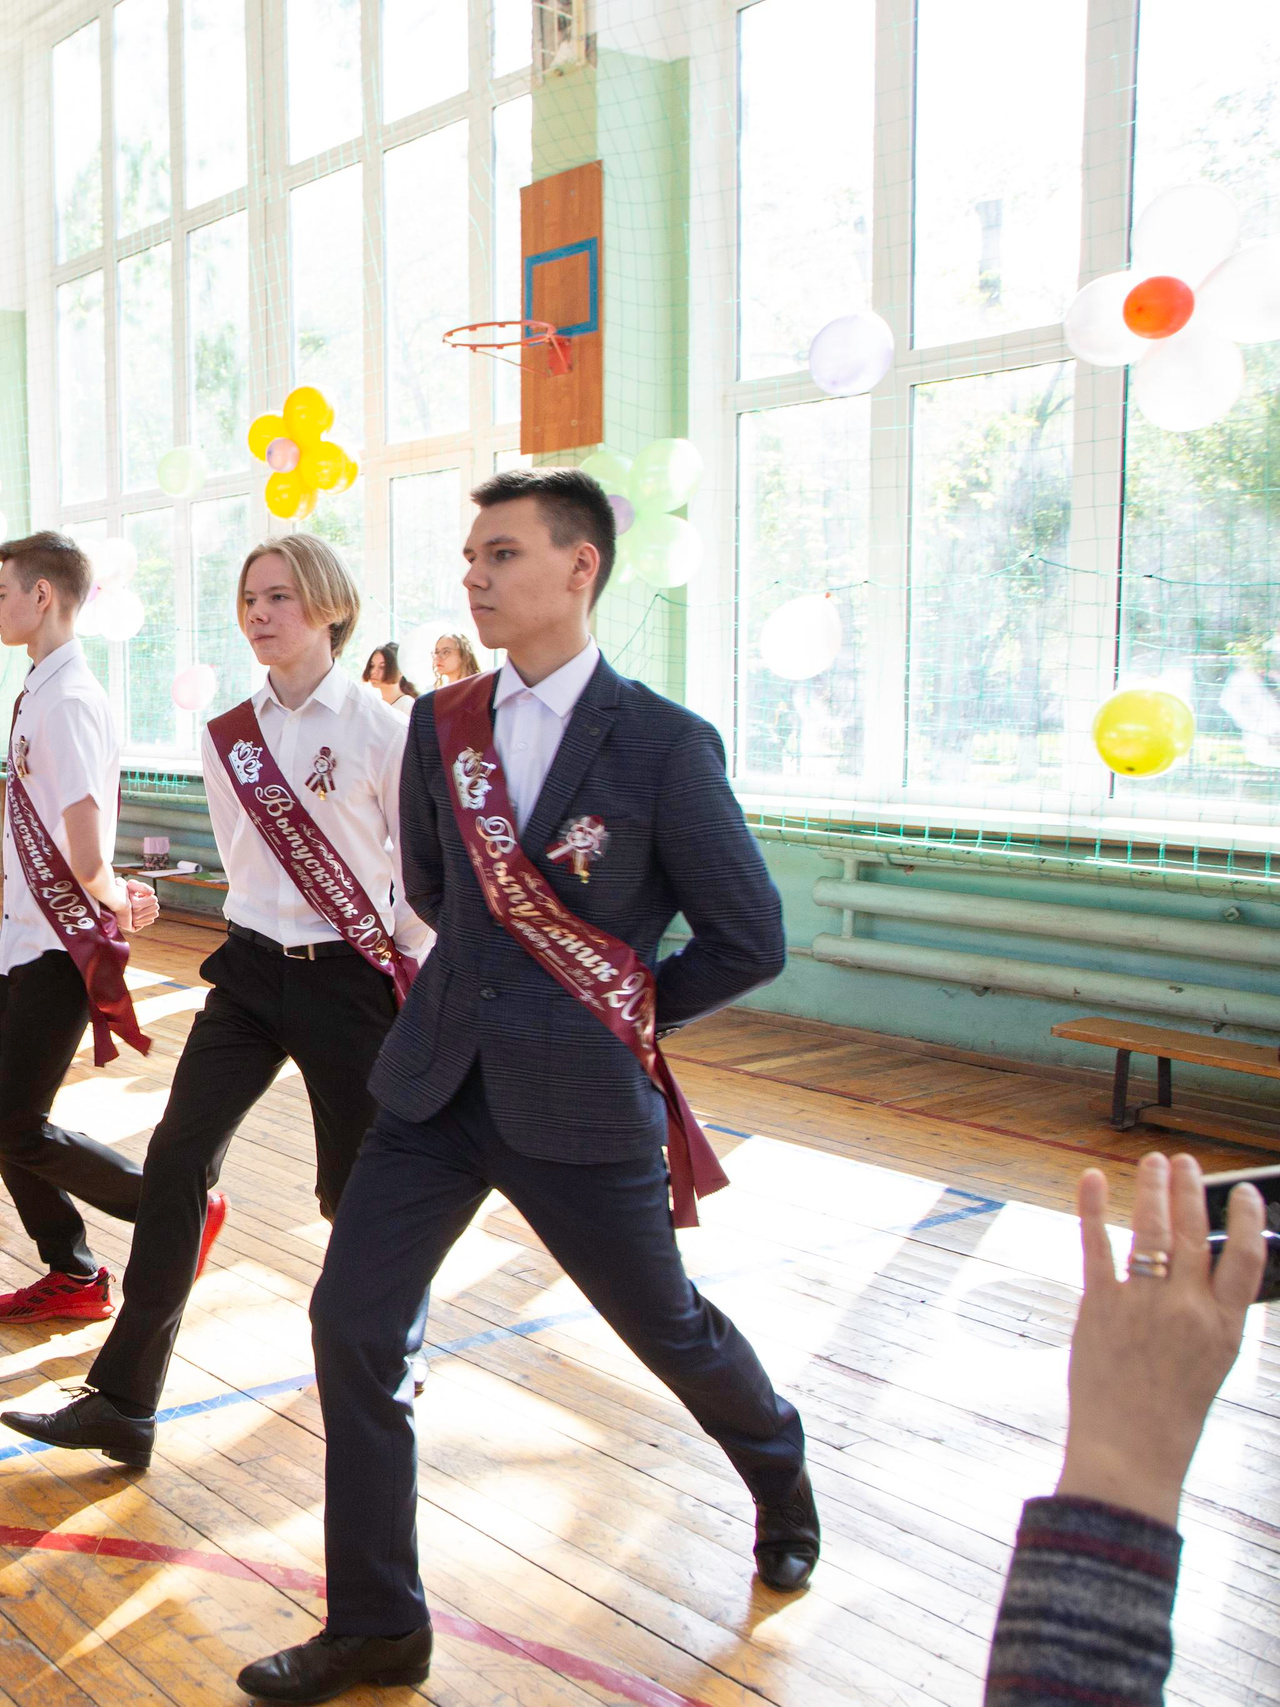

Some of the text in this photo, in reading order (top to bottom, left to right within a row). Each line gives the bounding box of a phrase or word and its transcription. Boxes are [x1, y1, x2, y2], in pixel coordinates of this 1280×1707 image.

[39, 880, 96, 936] 2022
[255, 784, 359, 919] Выпускник
[475, 816, 619, 982] Выпускник
